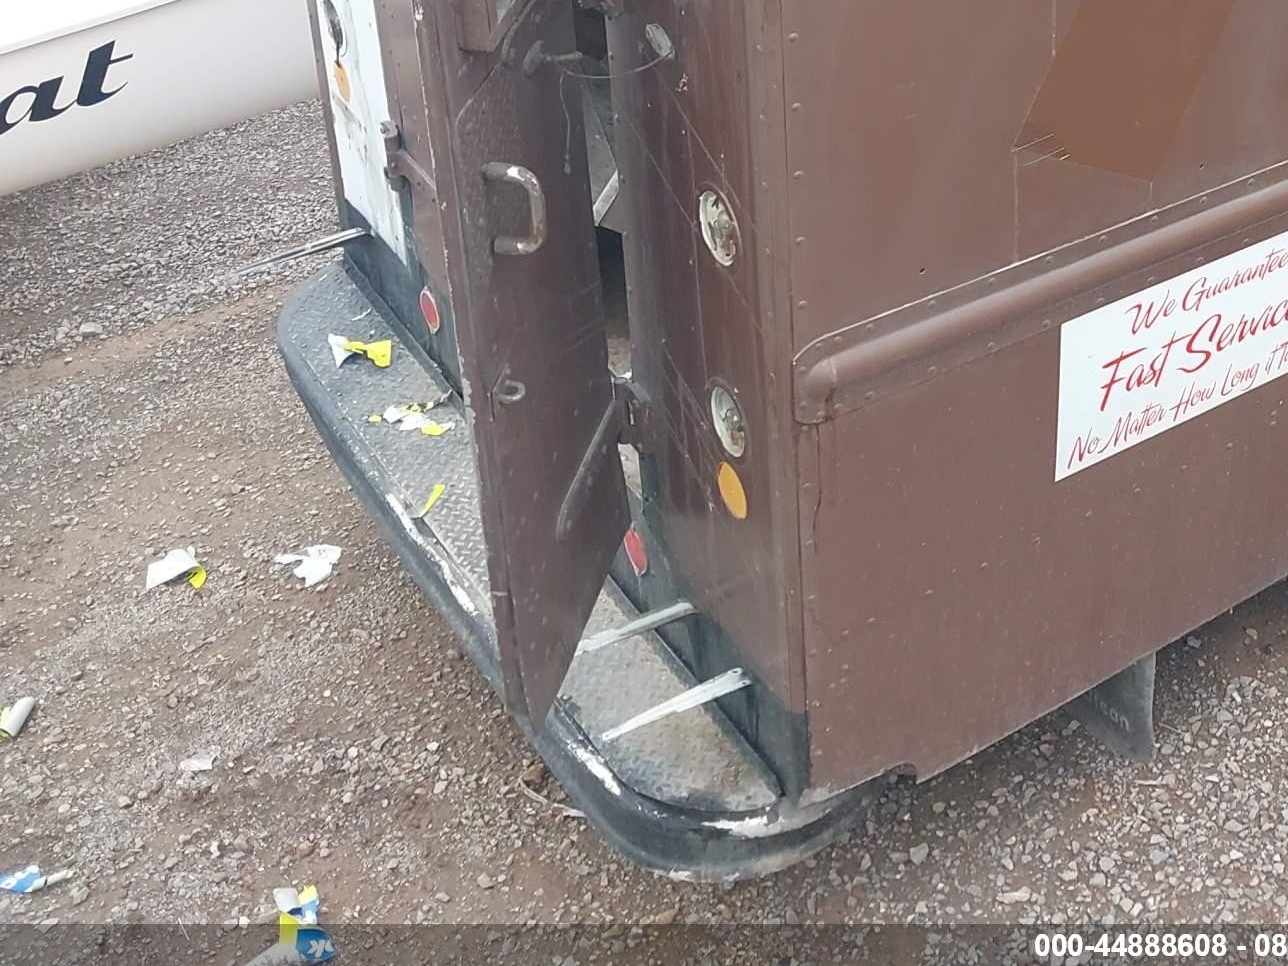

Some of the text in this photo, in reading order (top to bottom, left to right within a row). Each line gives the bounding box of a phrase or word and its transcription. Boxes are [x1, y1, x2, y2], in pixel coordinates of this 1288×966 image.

[1124, 289, 1177, 335] We
[1100, 331, 1190, 412] Fast
[1067, 427, 1101, 470] No
[1097, 403, 1167, 455] Matter
[1169, 379, 1218, 422] How
[1220, 362, 1260, 397] Long
